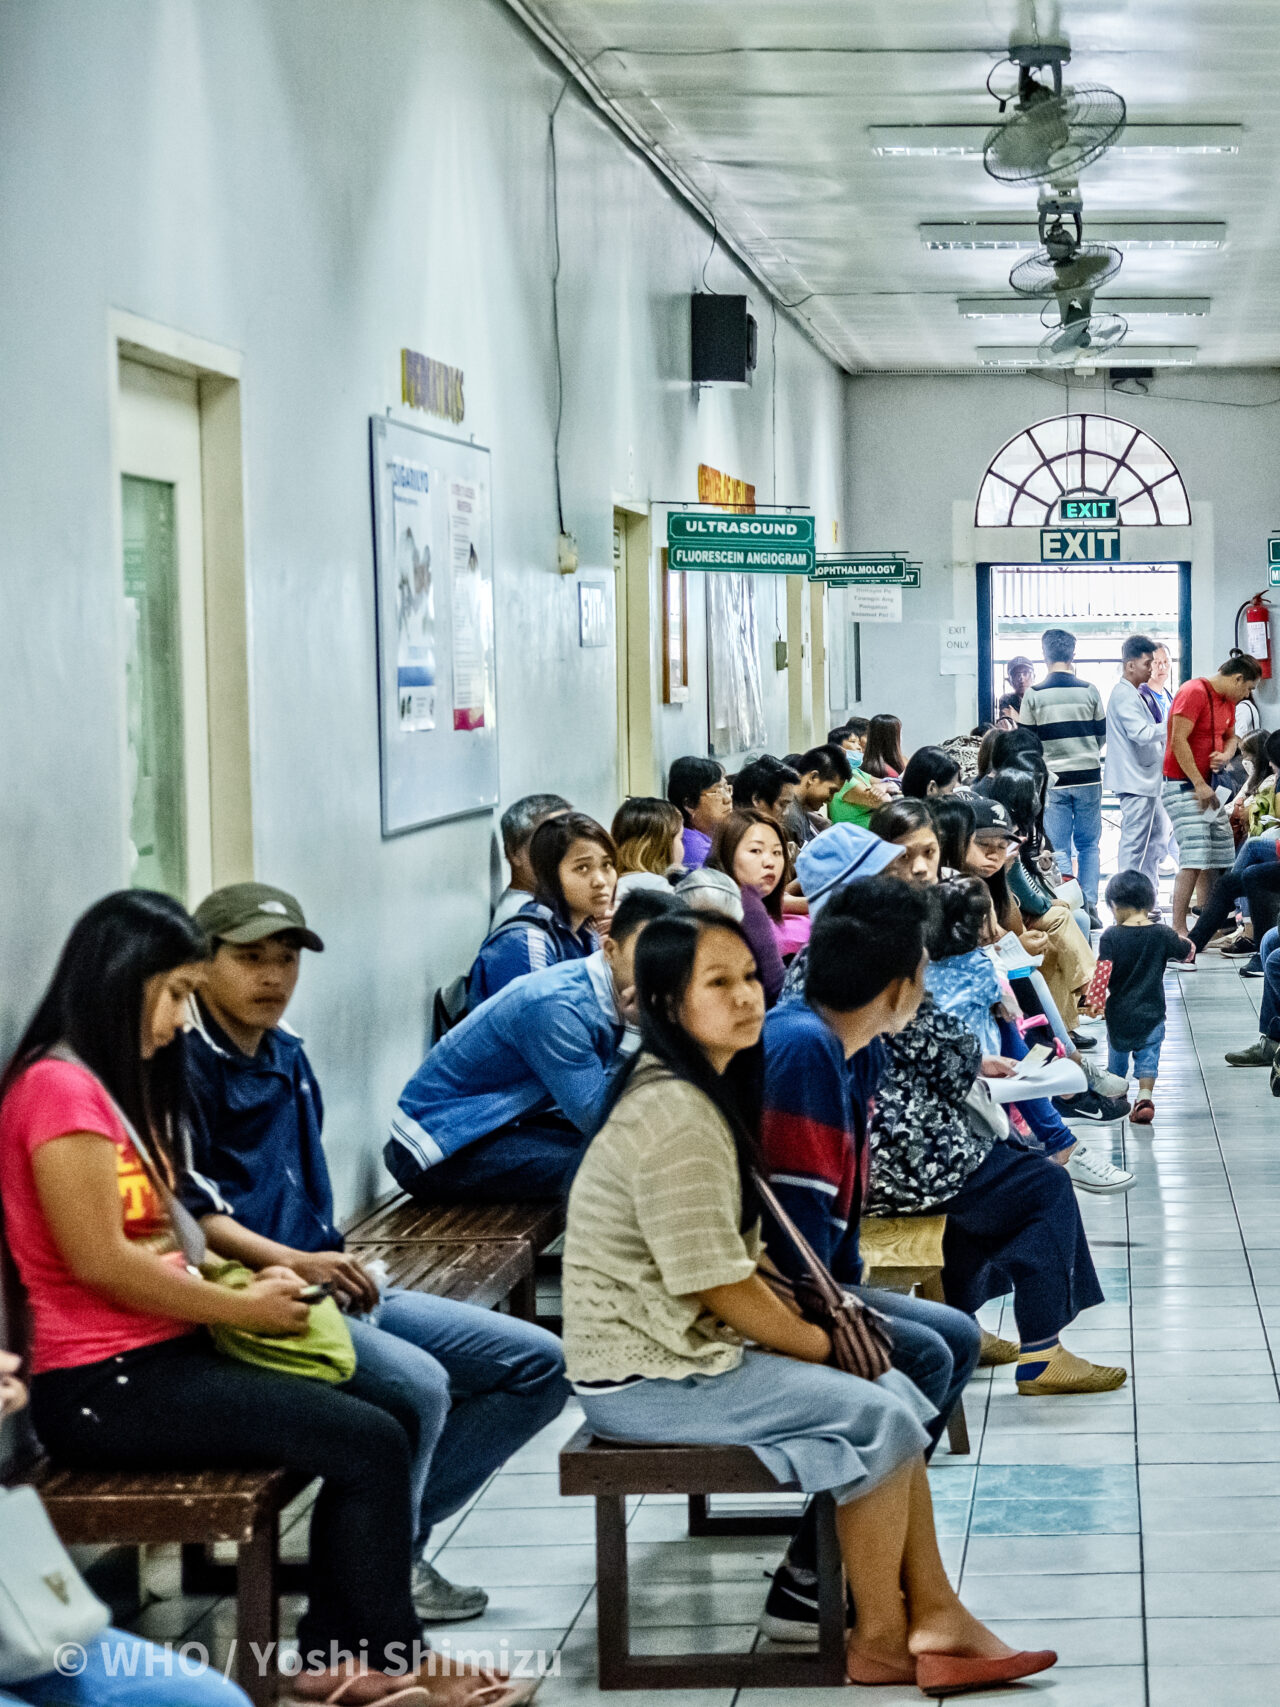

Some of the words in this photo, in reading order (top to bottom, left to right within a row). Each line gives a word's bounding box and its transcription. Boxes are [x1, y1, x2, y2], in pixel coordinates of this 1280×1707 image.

[1067, 502, 1111, 518] EXIT
[685, 520, 798, 536] ULTRASOUND
[1042, 532, 1119, 560] EXIT
[676, 550, 743, 564] FLUORESCEIN
[746, 552, 807, 566] ANGIOGRAM
[817, 563, 896, 576] OPHTHALMOLOGY
[949, 626, 967, 635] EXIT
[946, 640, 970, 649] ONLY
